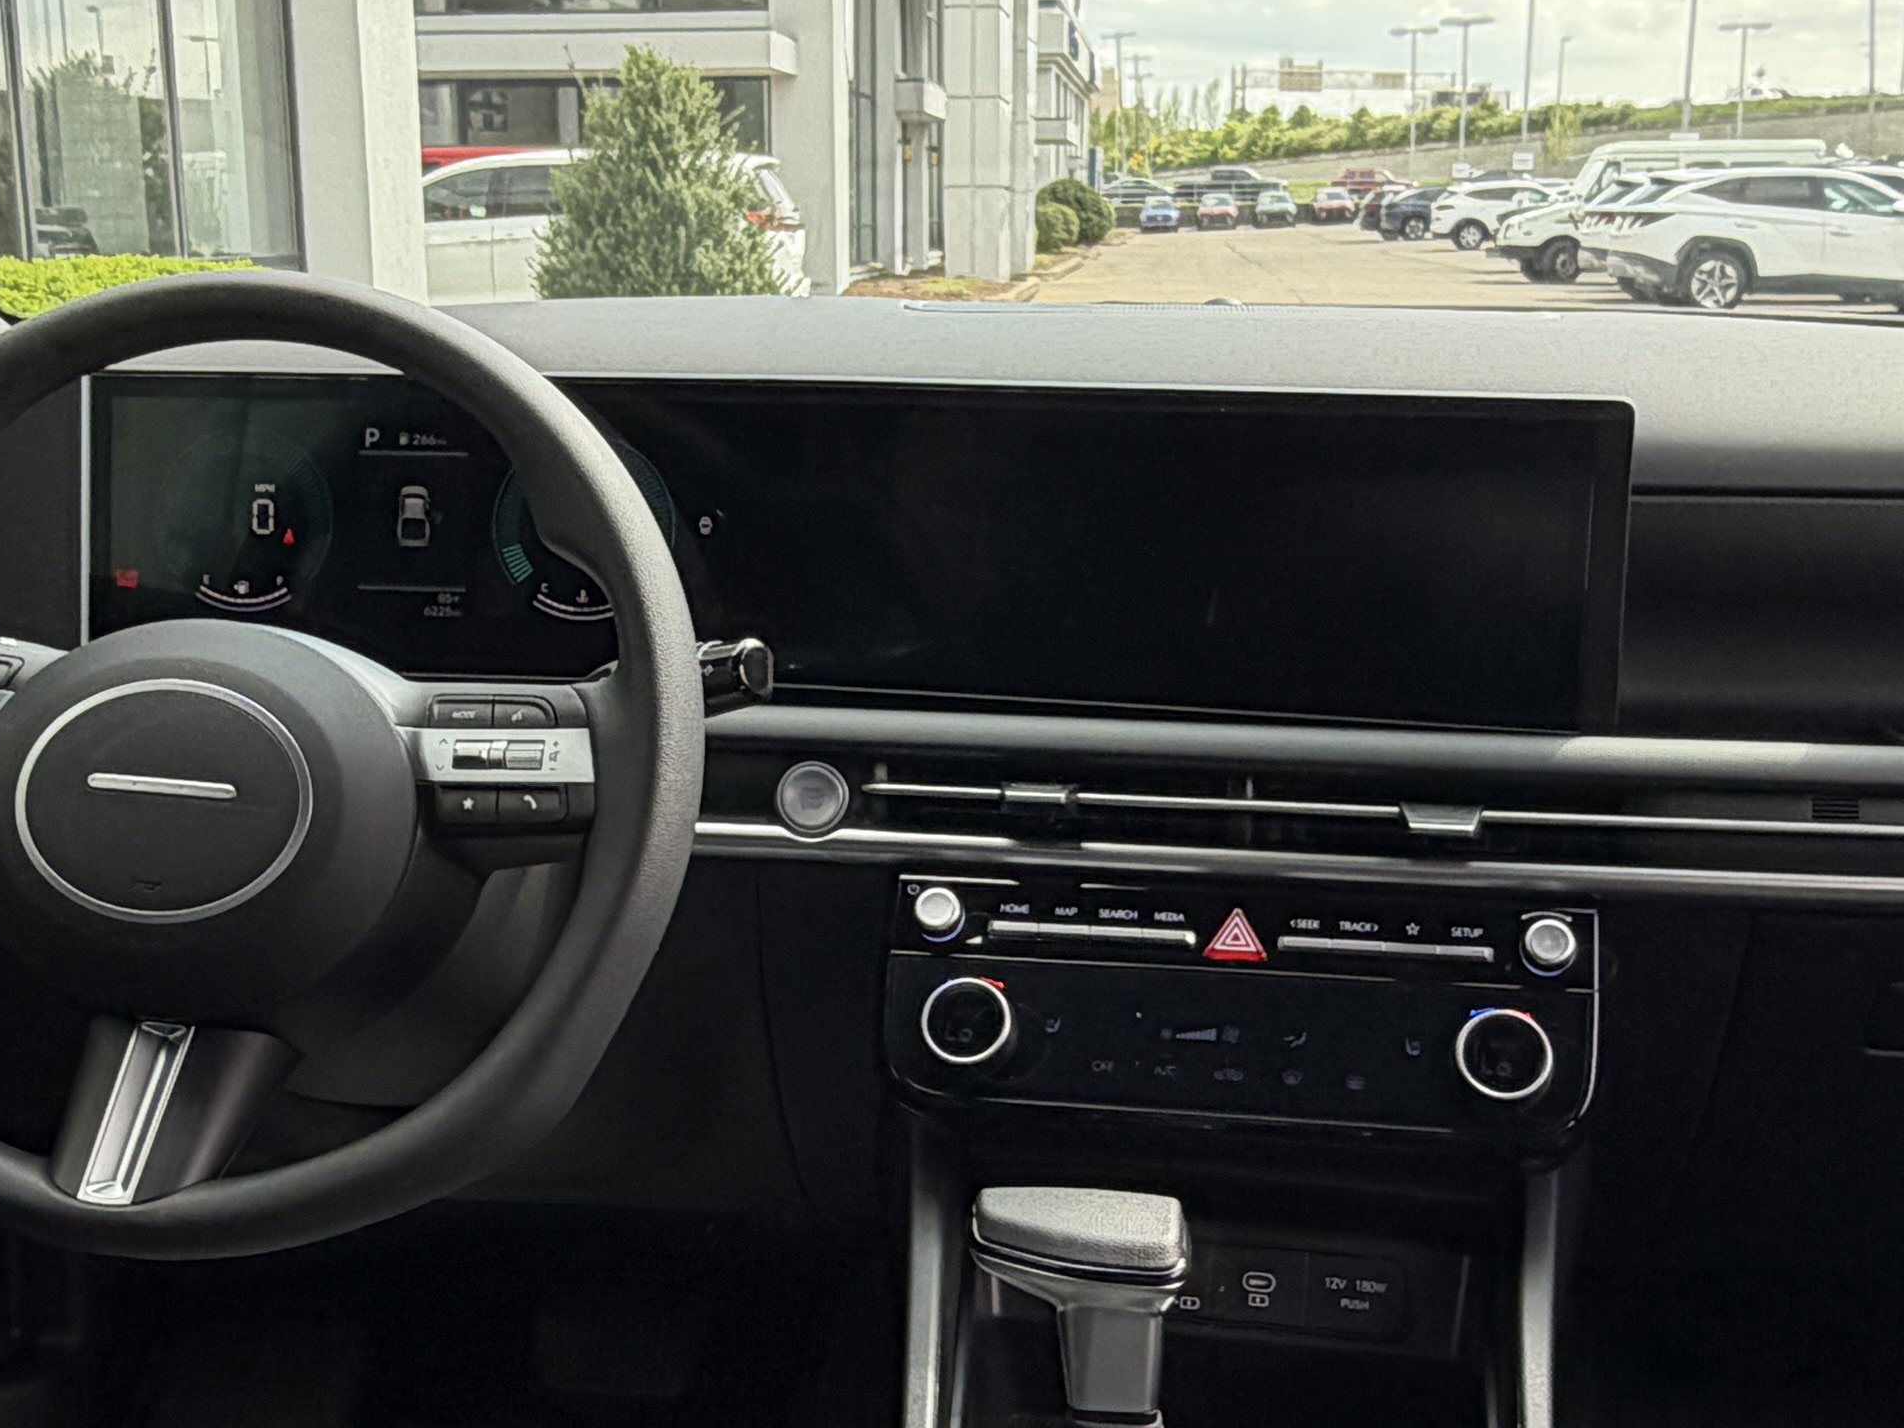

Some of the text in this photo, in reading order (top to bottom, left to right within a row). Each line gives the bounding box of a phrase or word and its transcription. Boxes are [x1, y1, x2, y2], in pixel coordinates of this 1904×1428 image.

[365, 428, 380, 448] P
[252, 498, 274, 535] 0
[541, 583, 549, 593] C
[1000, 903, 1030, 915] HOME
[1055, 906, 1079, 917] MAP
[1098, 908, 1139, 920] SEARCH
[1154, 911, 1185, 922] MEDIA
[1450, 926, 1484, 939] SETUP
